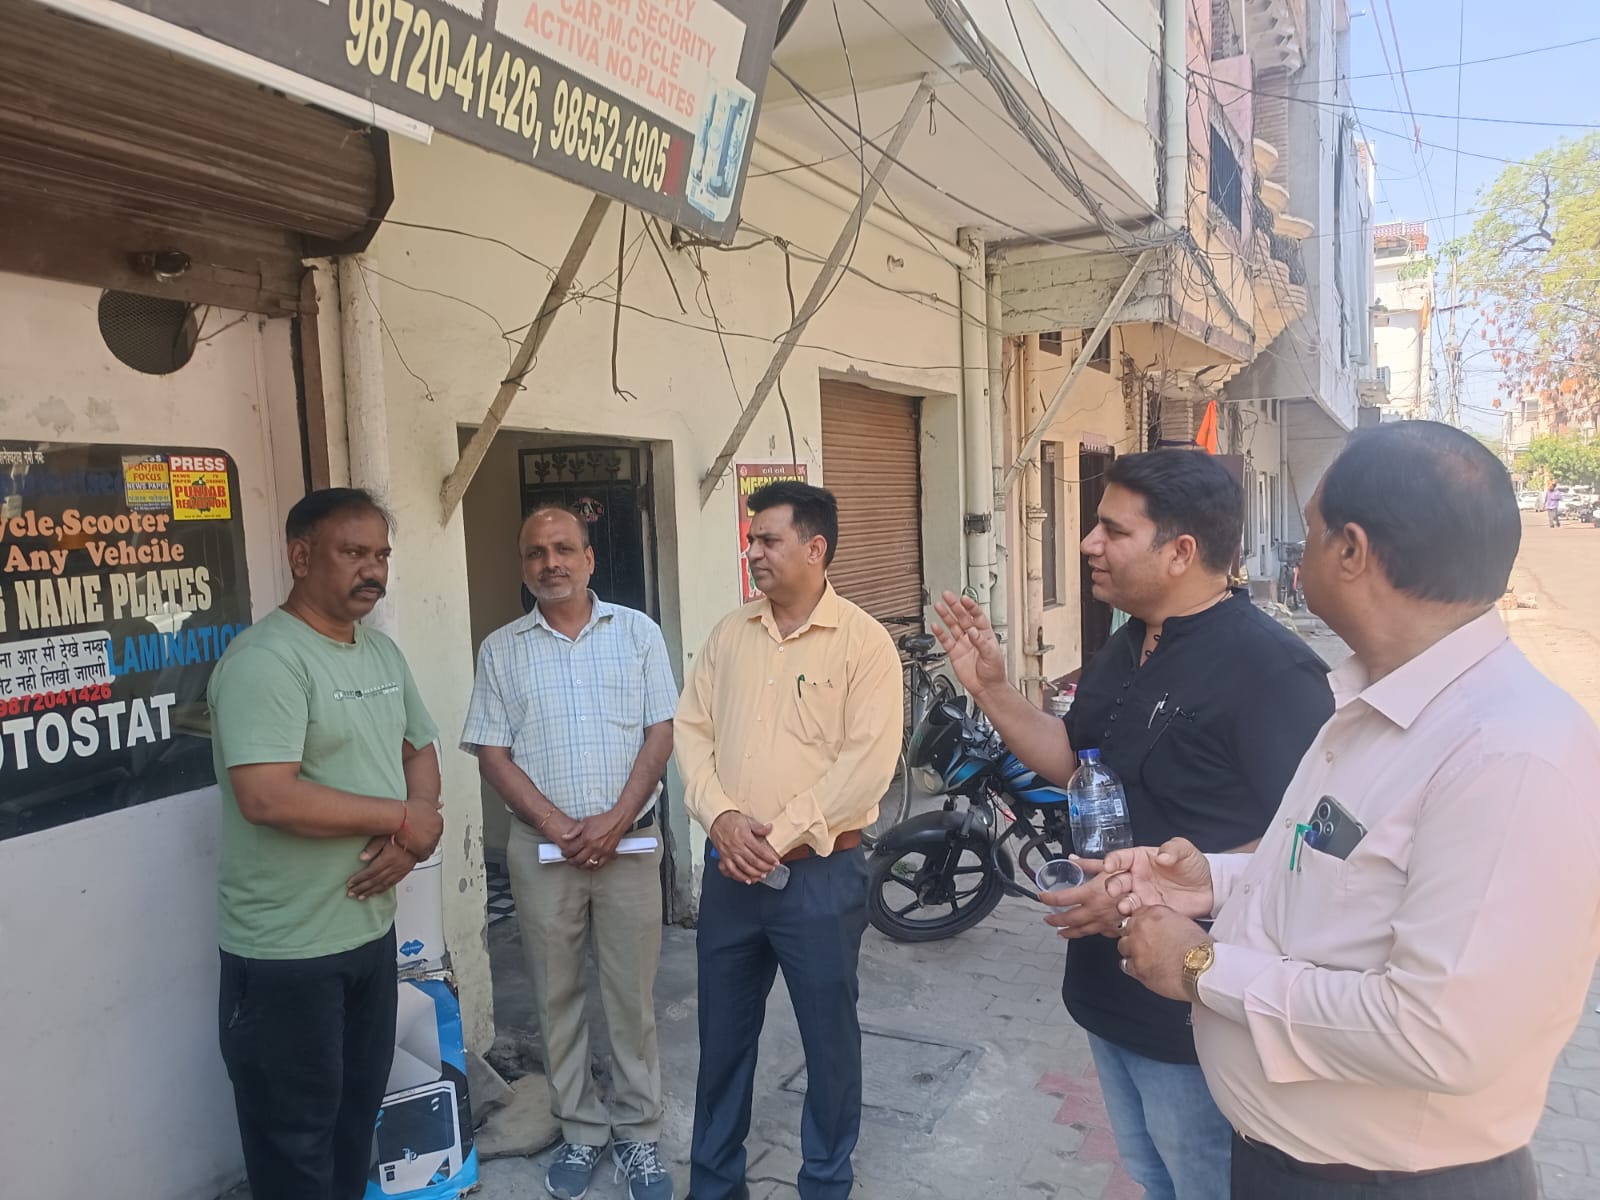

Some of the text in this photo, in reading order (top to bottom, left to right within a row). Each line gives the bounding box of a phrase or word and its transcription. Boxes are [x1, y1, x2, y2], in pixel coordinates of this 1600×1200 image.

[524, 2, 599, 66] ACTIVA
[636, 0, 717, 68] SECURITY
[550, 79, 684, 195] 98552-1905
[171, 456, 226, 471] PRESS
[4, 537, 185, 575] Any Vehcile
[15, 575, 104, 630] NAME
[109, 566, 212, 620] PLATES
[18, 648, 38, 666] आर
[42, 638, 55, 662] सी
[60, 637, 79, 661] देखे
[40, 661, 70, 688] लिखी
[73, 656, 106, 684] जाएगी
[106, 624, 250, 677] LAMINATIO
[0, 683, 112, 717] 9872041426
[0, 693, 176, 770] TOSTAT
